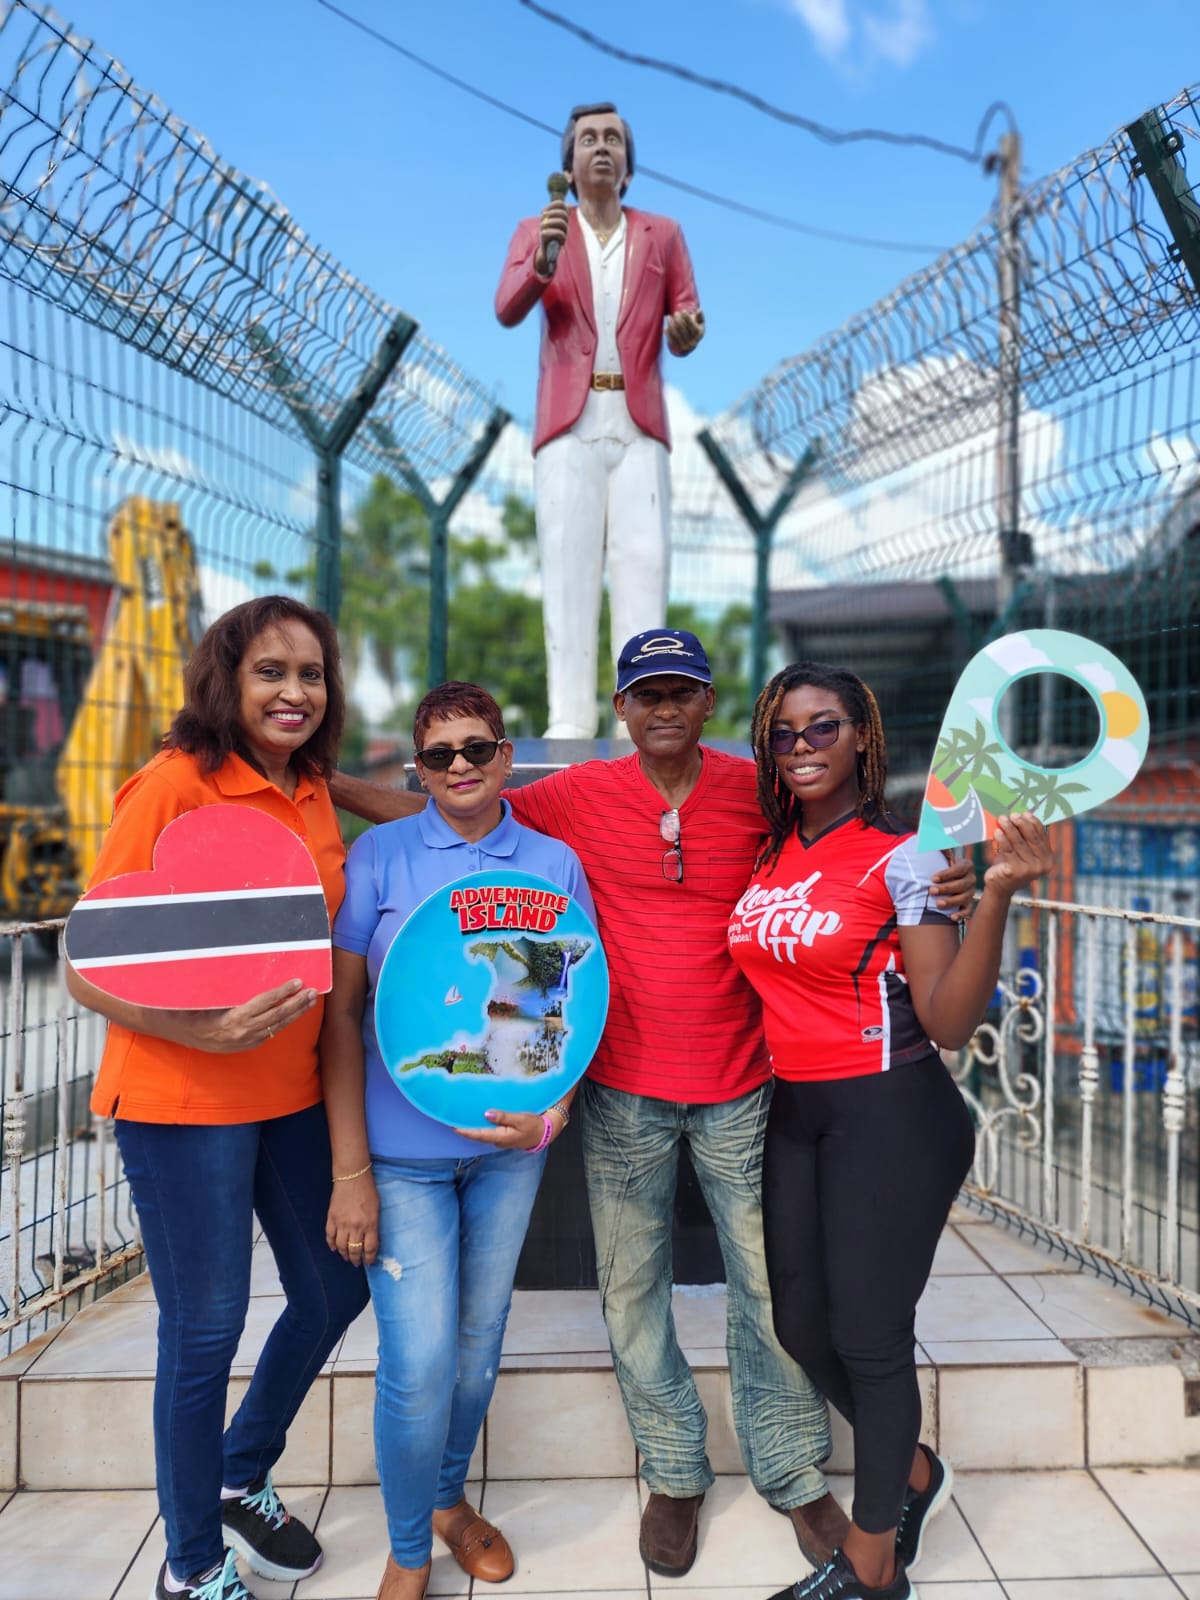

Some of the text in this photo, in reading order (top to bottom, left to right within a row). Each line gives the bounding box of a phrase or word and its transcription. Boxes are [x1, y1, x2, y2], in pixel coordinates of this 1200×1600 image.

[450, 887, 569, 914] ADVENTURE
[457, 903, 557, 935] ISLAND
[742, 898, 843, 951] Trip
[767, 936, 799, 964] TT
